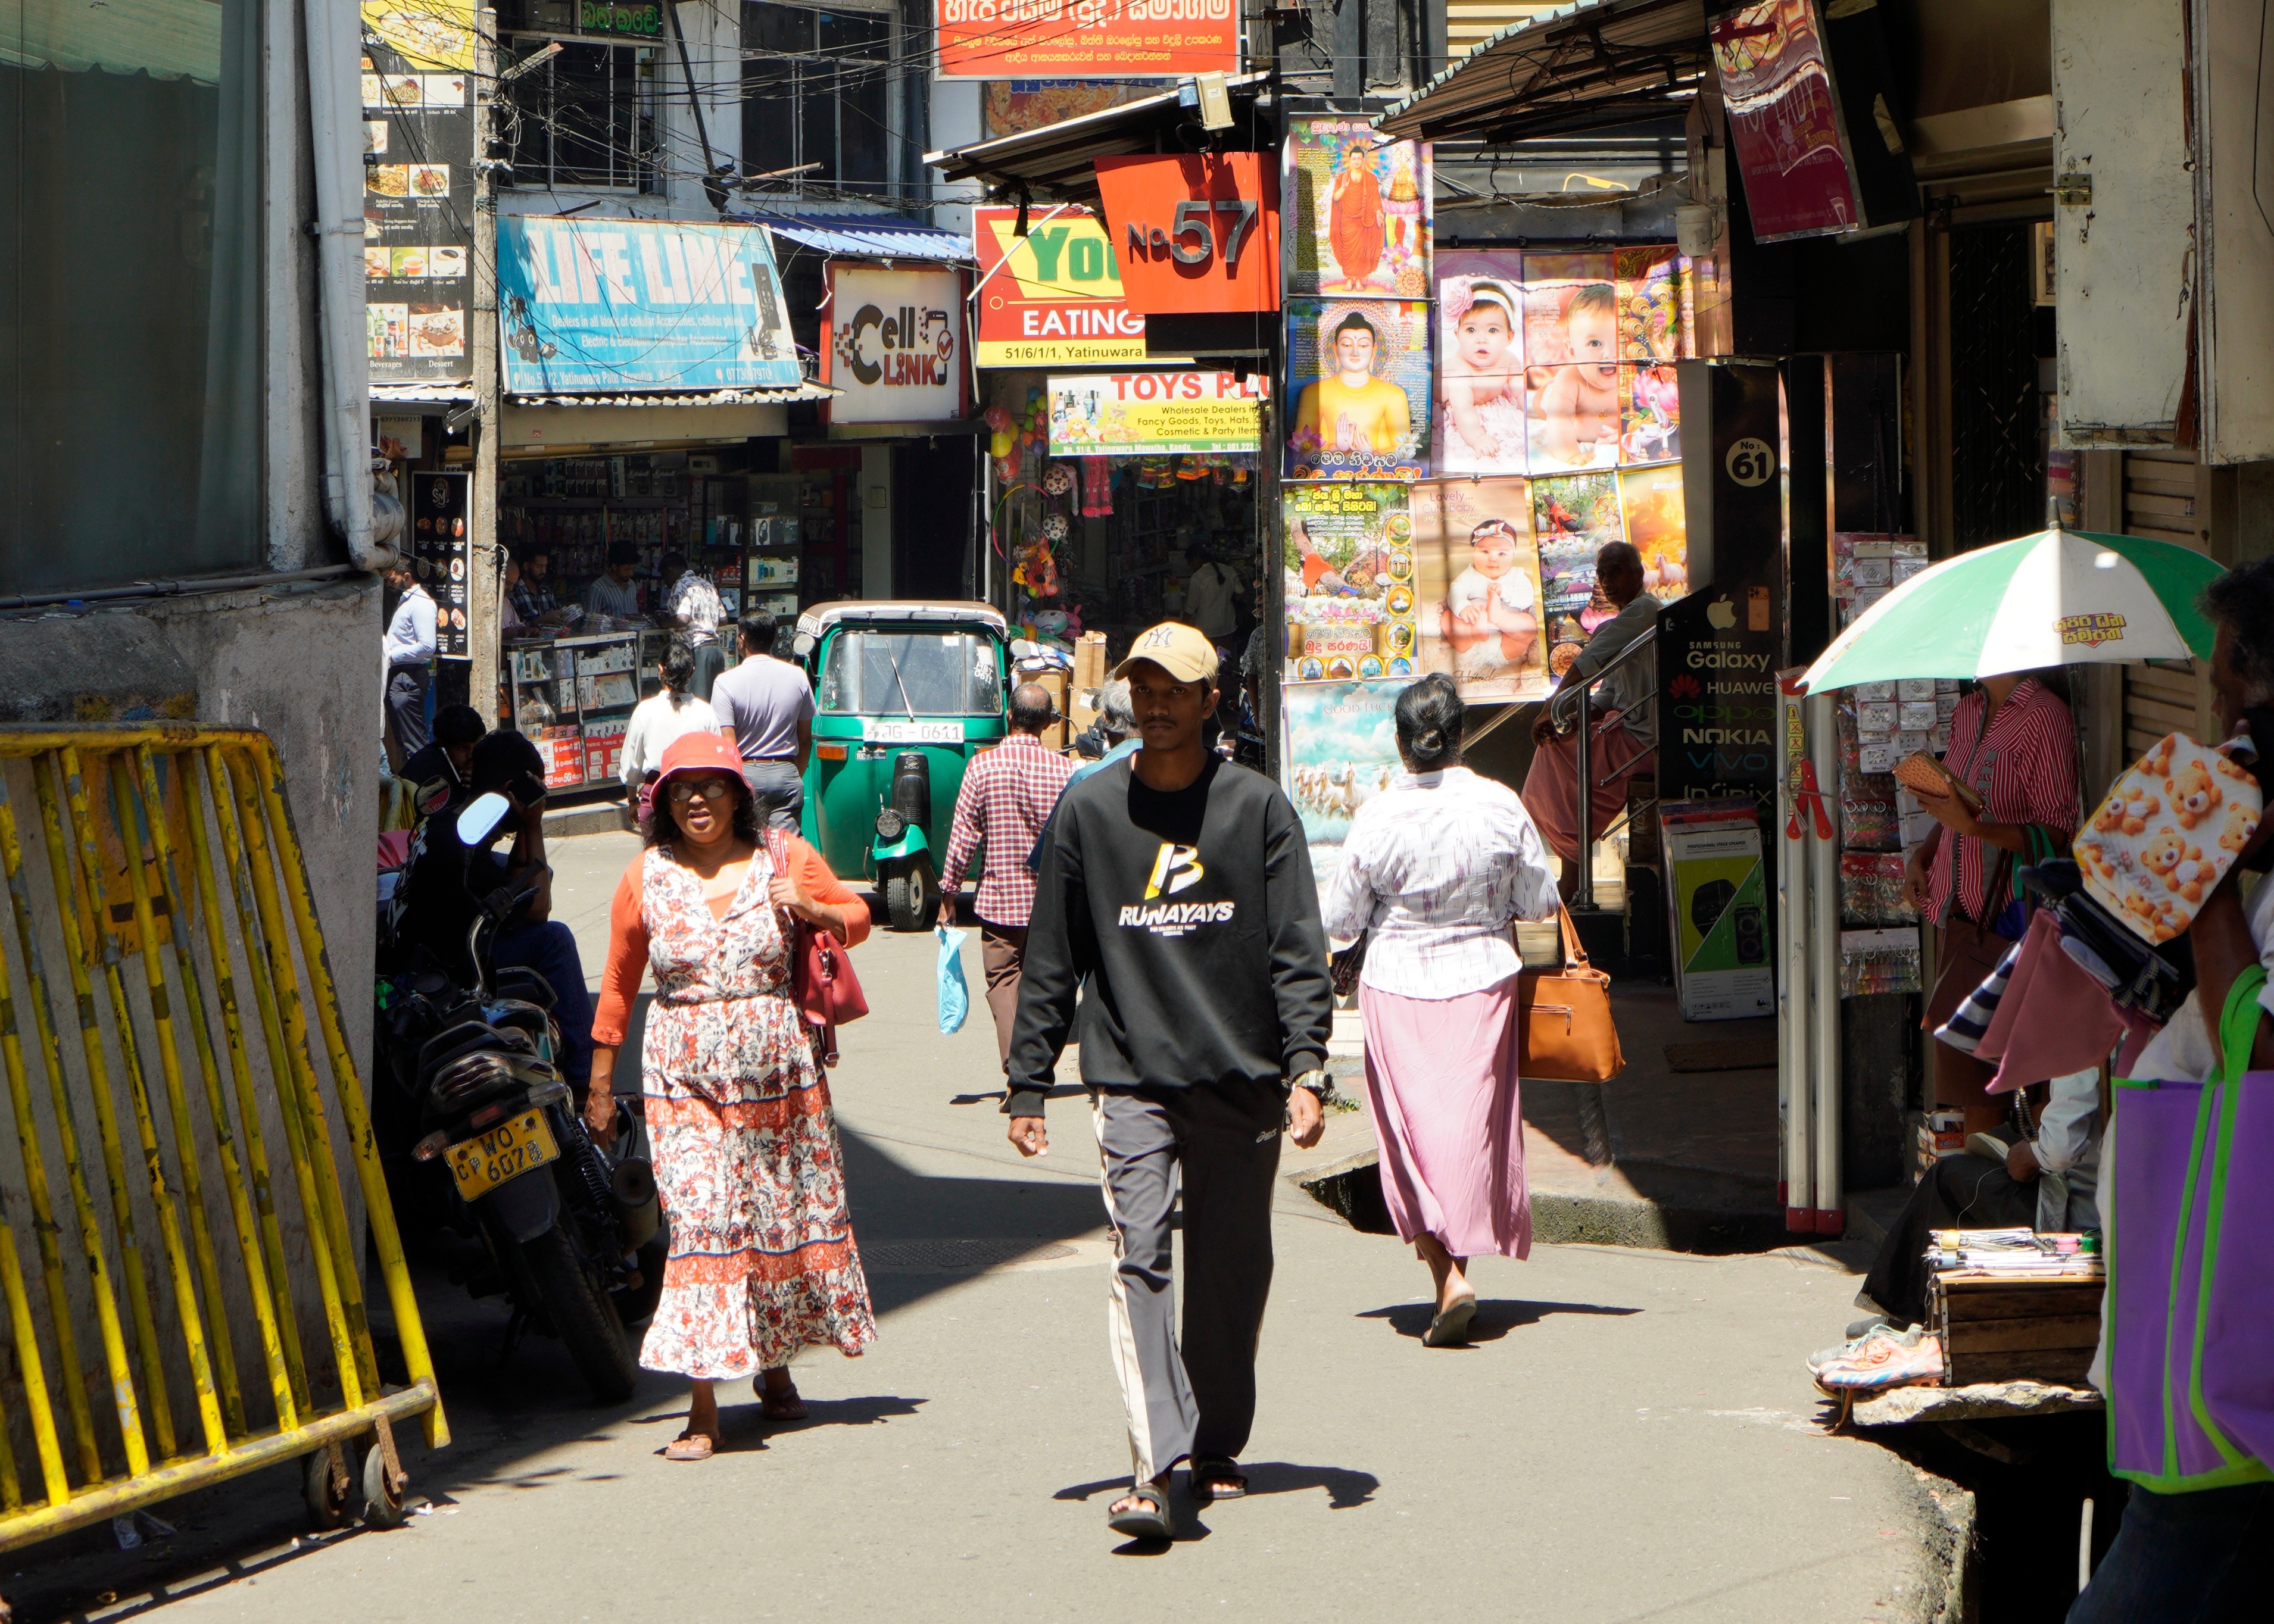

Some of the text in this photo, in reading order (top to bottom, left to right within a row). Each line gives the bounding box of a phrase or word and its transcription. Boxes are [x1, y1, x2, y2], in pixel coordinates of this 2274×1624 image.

[1171, 201, 1258, 265] 57
[526, 229, 753, 305] LIFE LINE
[551, 314, 579, 327] Dealers
[581, 315, 588, 327] in
[589, 315, 599, 327] all
[600, 314, 619, 327] kinds
[621, 315, 629, 327] of
[698, 315, 722, 326] cellular
[1023, 309, 1145, 336] EATING
[581, 335, 607, 348] Electric
[610, 336, 616, 346] &
[1005, 345, 1143, 361] 51/6/1/1, Yatinuwara
[369, 360, 403, 370] Beverages
[560, 371, 601, 385] Yatinuwara
[1111, 374, 1202, 400] TOYS
[1162, 405, 1208, 414] Wholesale
[1212, 405, 1246, 414] Dealers
[1137, 417, 1252, 427] Fancy Goods, Toys, Hats,
[1157, 427, 1199, 436] Cosmetic
[1212, 427, 1236, 437] Party
[1094, 444, 1133, 452] Yatinuwara
[1311, 451, 1398, 467] මෙම නිවසට
[1732, 452, 1767, 480] 61
[1422, 504, 1446, 513] Cute
[1449, 502, 1475, 513] Baby
[1304, 638, 1372, 655] බුදු සරණයි!
[1689, 641, 1742, 649] SAMSUNG
[1686, 650, 1771, 673] Galaxy
[1707, 682, 1776, 694] HUAWE
[1324, 702, 1395, 714] GOOD LUCK
[1674, 705, 1777, 724] oppo
[921, 725, 961, 739] 0611
[1683, 727, 1773, 745] NOKIA
[1686, 748, 1768, 772] vivo
[456, 1140, 542, 1182] CP 6078
